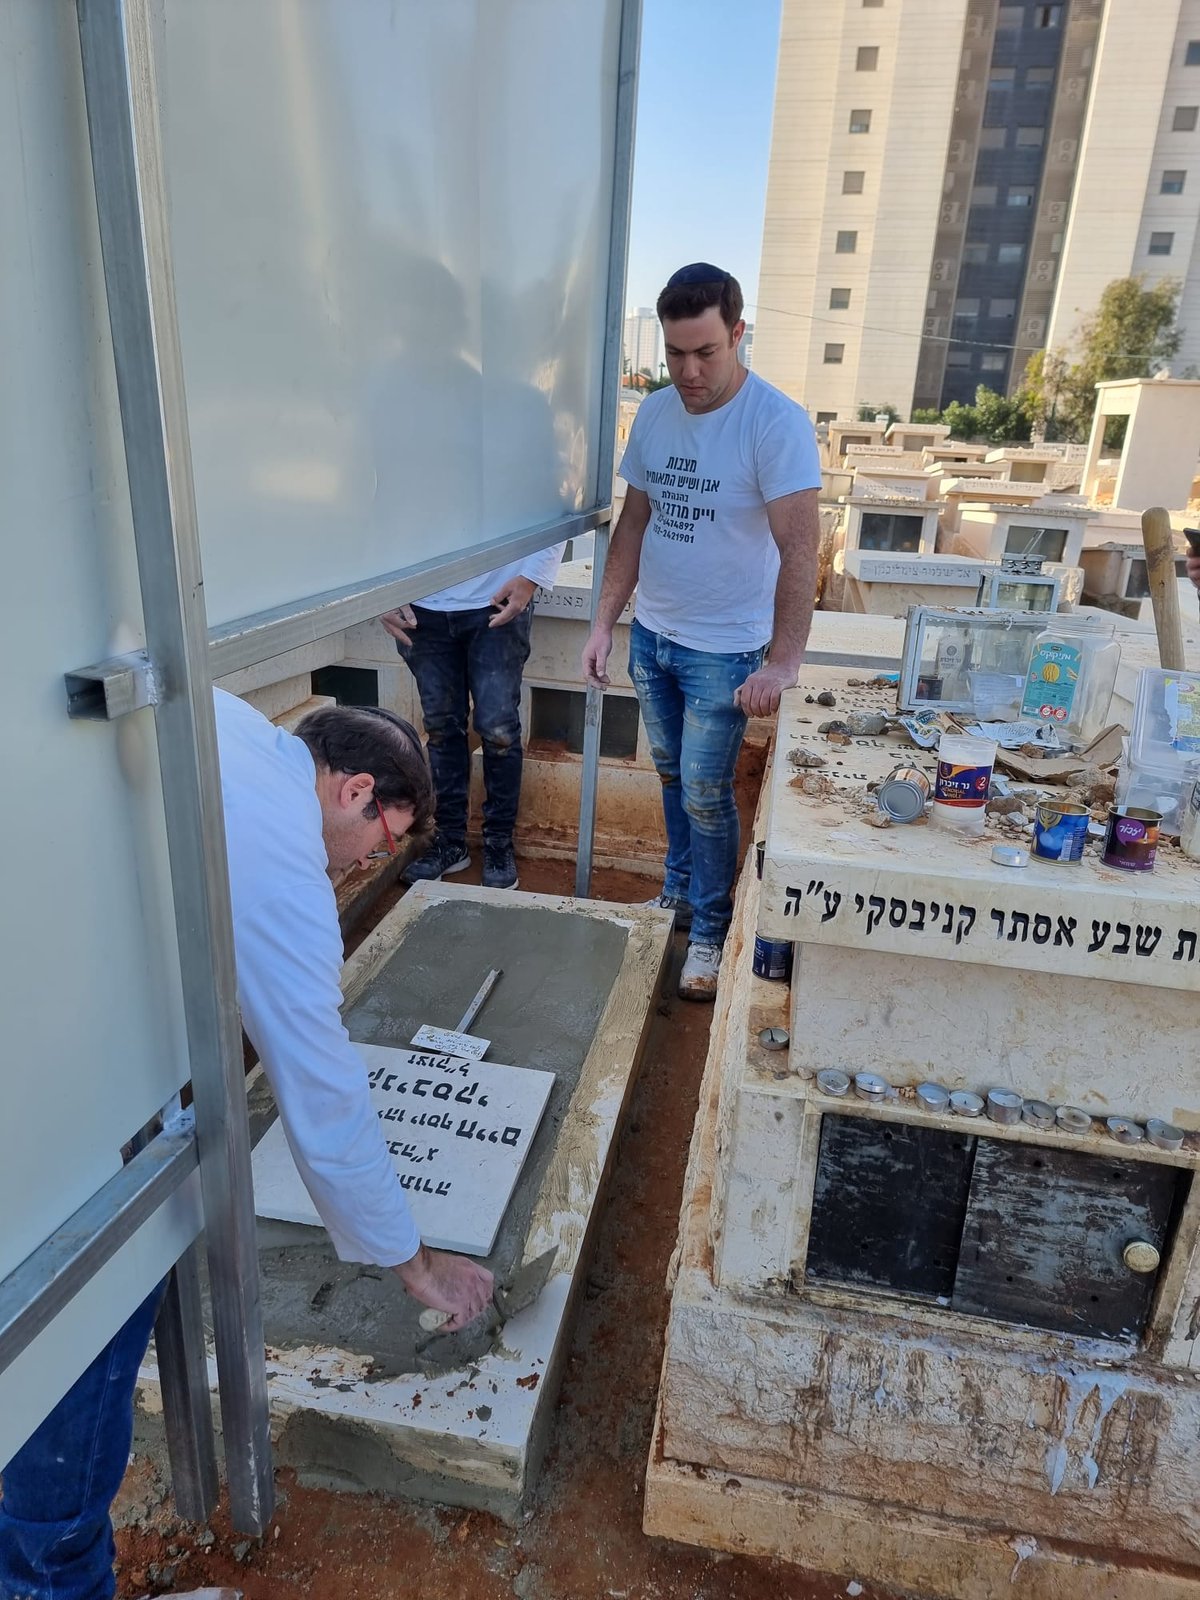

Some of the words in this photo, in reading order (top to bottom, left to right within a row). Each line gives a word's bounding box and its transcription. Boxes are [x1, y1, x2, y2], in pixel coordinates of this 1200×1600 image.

[666, 456, 697, 473] מצבות
[677, 475, 700, 490] ושיש
[700, 478, 721, 494] אבן
[661, 490, 689, 503] בהנהלת
[692, 507, 715, 521] וייס
[939, 778, 959, 788] זיכרון
[980, 776, 986, 786] 2
[783, 880, 842, 923] ע"ה
[854, 892, 976, 944] קניבסקי
[990, 907, 1078, 947] אסתר
[1087, 918, 1163, 956] שבע
[407, 1053, 471, 1077] זצוק"ל
[368, 1067, 490, 1108] קניבסקי
[410, 1112, 454, 1131] יוסף
[455, 1118, 522, 1147] חיים
[396, 1173, 453, 1197] תורה
